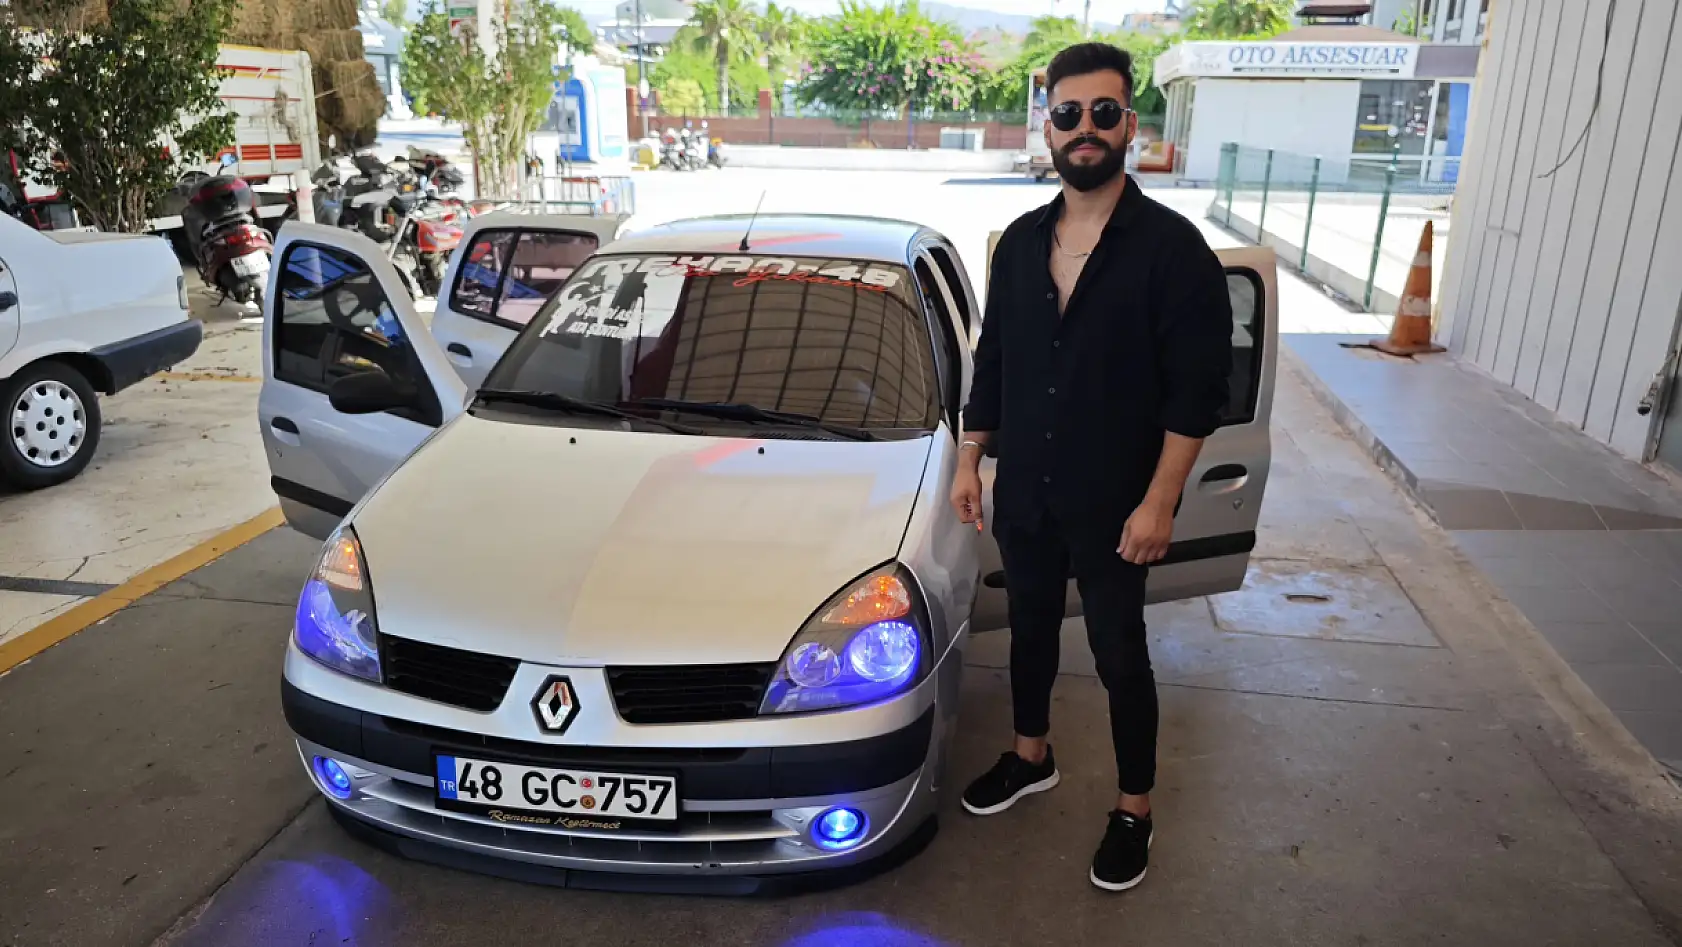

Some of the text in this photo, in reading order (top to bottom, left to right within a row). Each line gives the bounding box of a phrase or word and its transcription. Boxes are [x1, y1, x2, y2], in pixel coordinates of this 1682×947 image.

[1229, 45, 1408, 66] OTO AKSESUAR
[440, 779, 456, 792] TR
[458, 762, 672, 816] 48 GC 757
[488, 809, 551, 824] Ramazan
